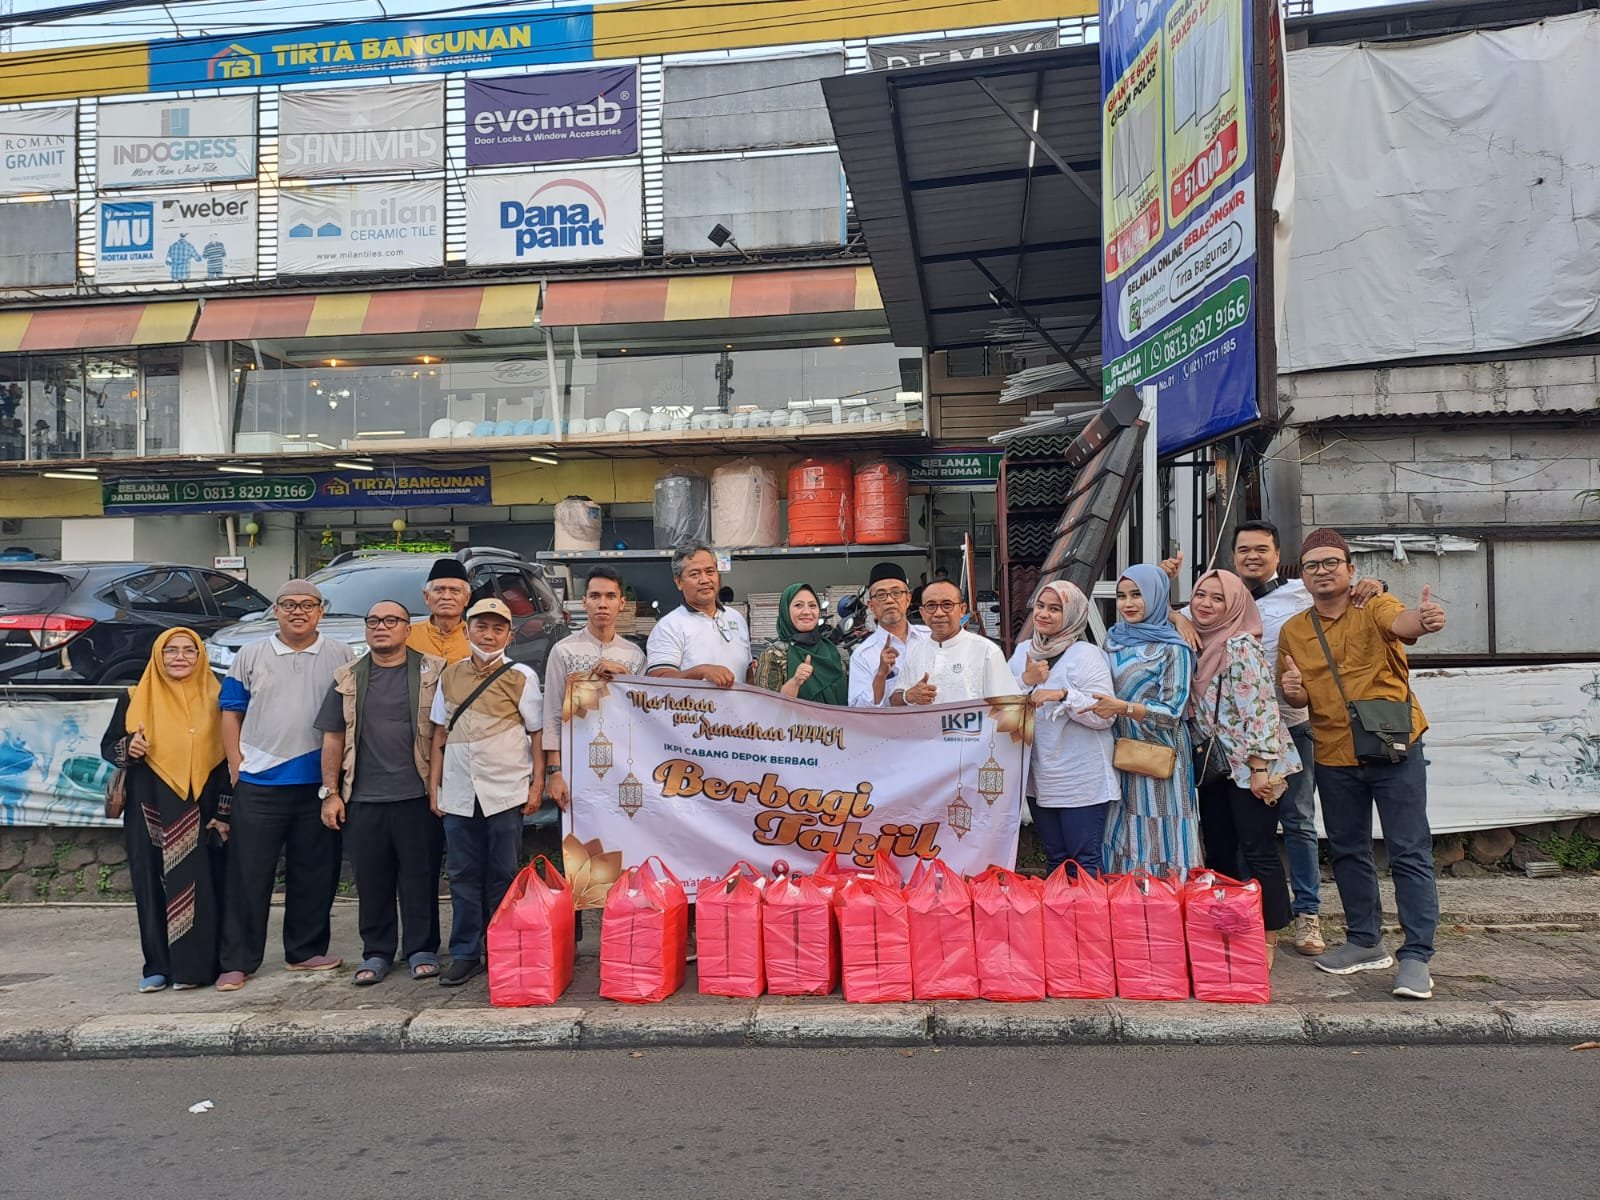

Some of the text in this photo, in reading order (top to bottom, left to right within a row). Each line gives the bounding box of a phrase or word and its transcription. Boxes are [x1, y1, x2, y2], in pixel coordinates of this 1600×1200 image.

[272, 25, 531, 66] TIRTA BANGUNAN
[1133, 63, 1156, 100] POLOS
[474, 95, 621, 134] evomab
[6, 136, 65, 150] ROMAN
[285, 123, 437, 165] SANJIMAS
[474, 128, 622, 145] Door Locks & Window Accessories
[6, 150, 65, 169] GRANIT
[113, 138, 237, 165] INDOGRESS
[180, 198, 249, 218] weber
[351, 197, 437, 227] milan
[500, 201, 589, 229] Dana
[105, 218, 150, 248] MU
[350, 225, 437, 241] CERAMIC TILE
[516, 218, 604, 256] paint
[130, 252, 153, 260] UTAMA
[1127, 268, 1157, 297] BELANJA
[1158, 242, 1183, 272] ONLINE
[1176, 268, 1192, 288] Tirta
[1164, 294, 1245, 363] 0813 8297 9166
[1204, 348, 1219, 366] 7721
[911, 467, 982, 477] DARI RUMAH
[921, 458, 981, 468] BELANJA
[118, 484, 168, 493] BELANJA
[203, 485, 306, 499] 0813 8297 9166
[352, 475, 485, 490] TIRTA BANGUNAN
[135, 493, 170, 501] RUMAH
[626, 690, 716, 714] Marhaban
[672, 712, 699, 727] yaa
[693, 715, 786, 741] Ramadhan
[941, 711, 982, 729] IKPI
[663, 743, 819, 767] IKPI CABANG DEPOK BERBAGI
[652, 758, 874, 826] Berbagi
